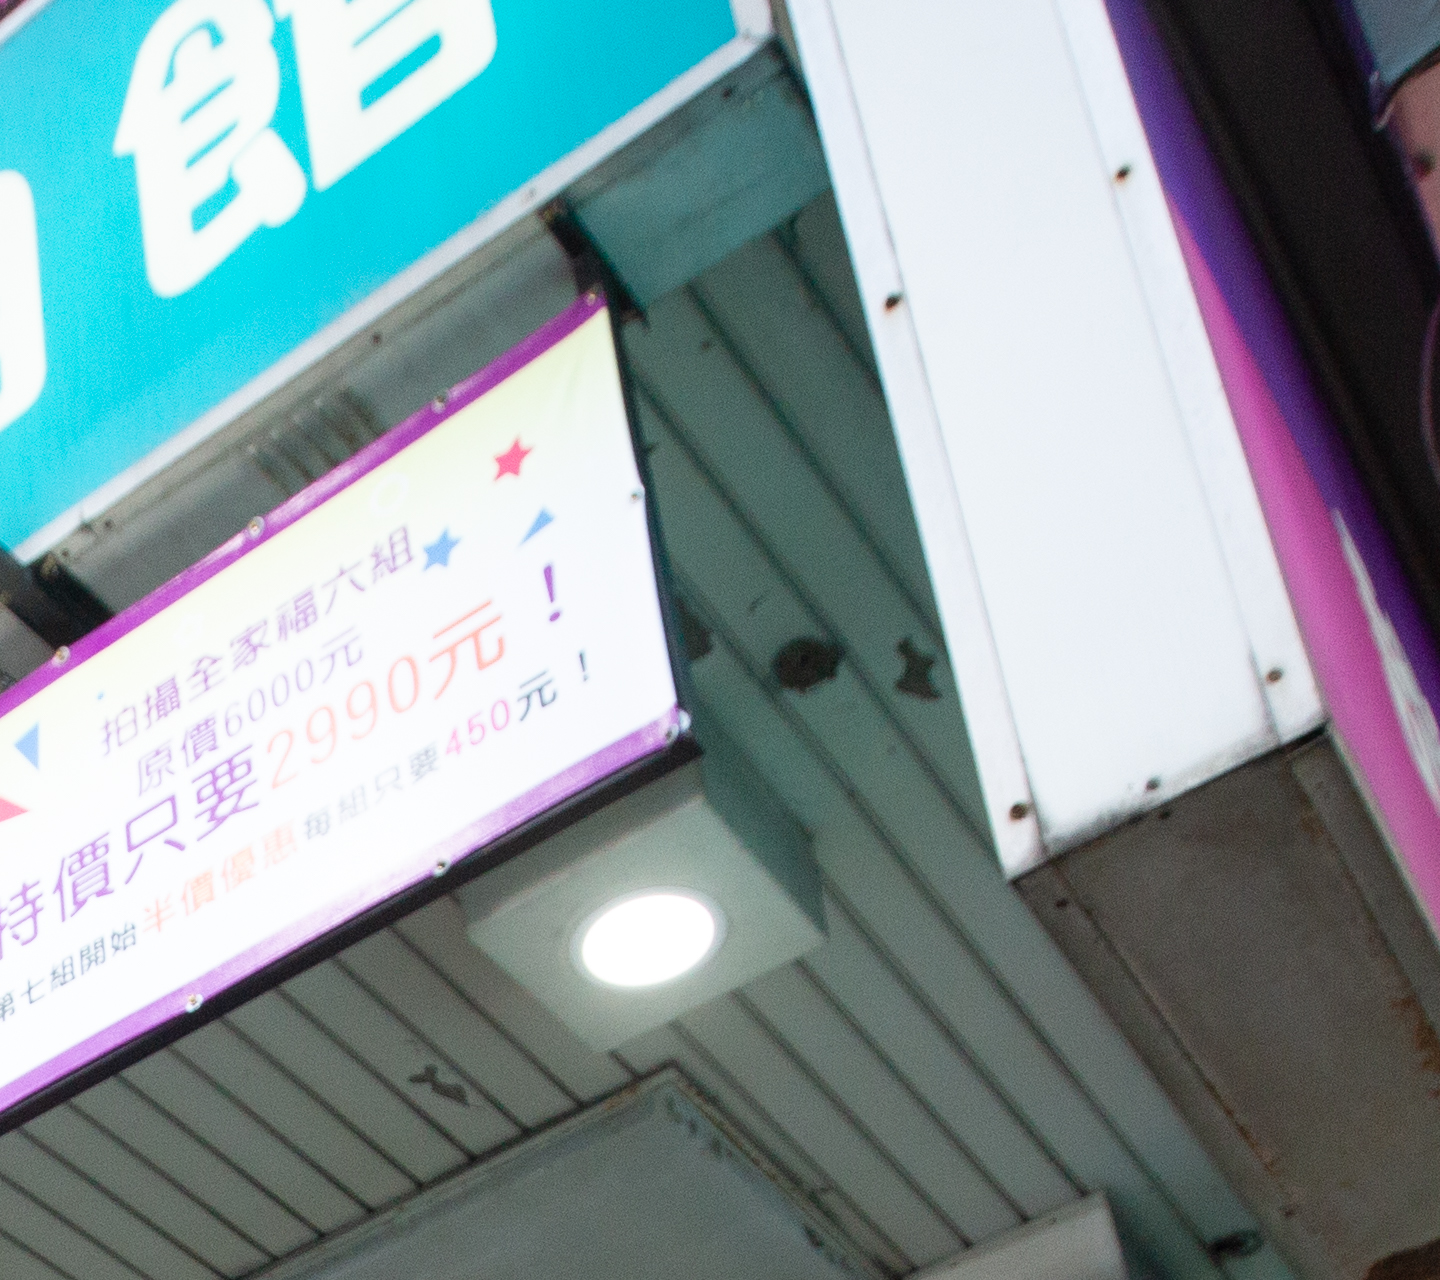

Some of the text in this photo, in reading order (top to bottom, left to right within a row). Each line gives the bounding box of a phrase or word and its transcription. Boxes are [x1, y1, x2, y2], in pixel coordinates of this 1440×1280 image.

[102, 524, 415, 757] 拍攝全家福六組
[137, 628, 365, 798] 原價6000元
